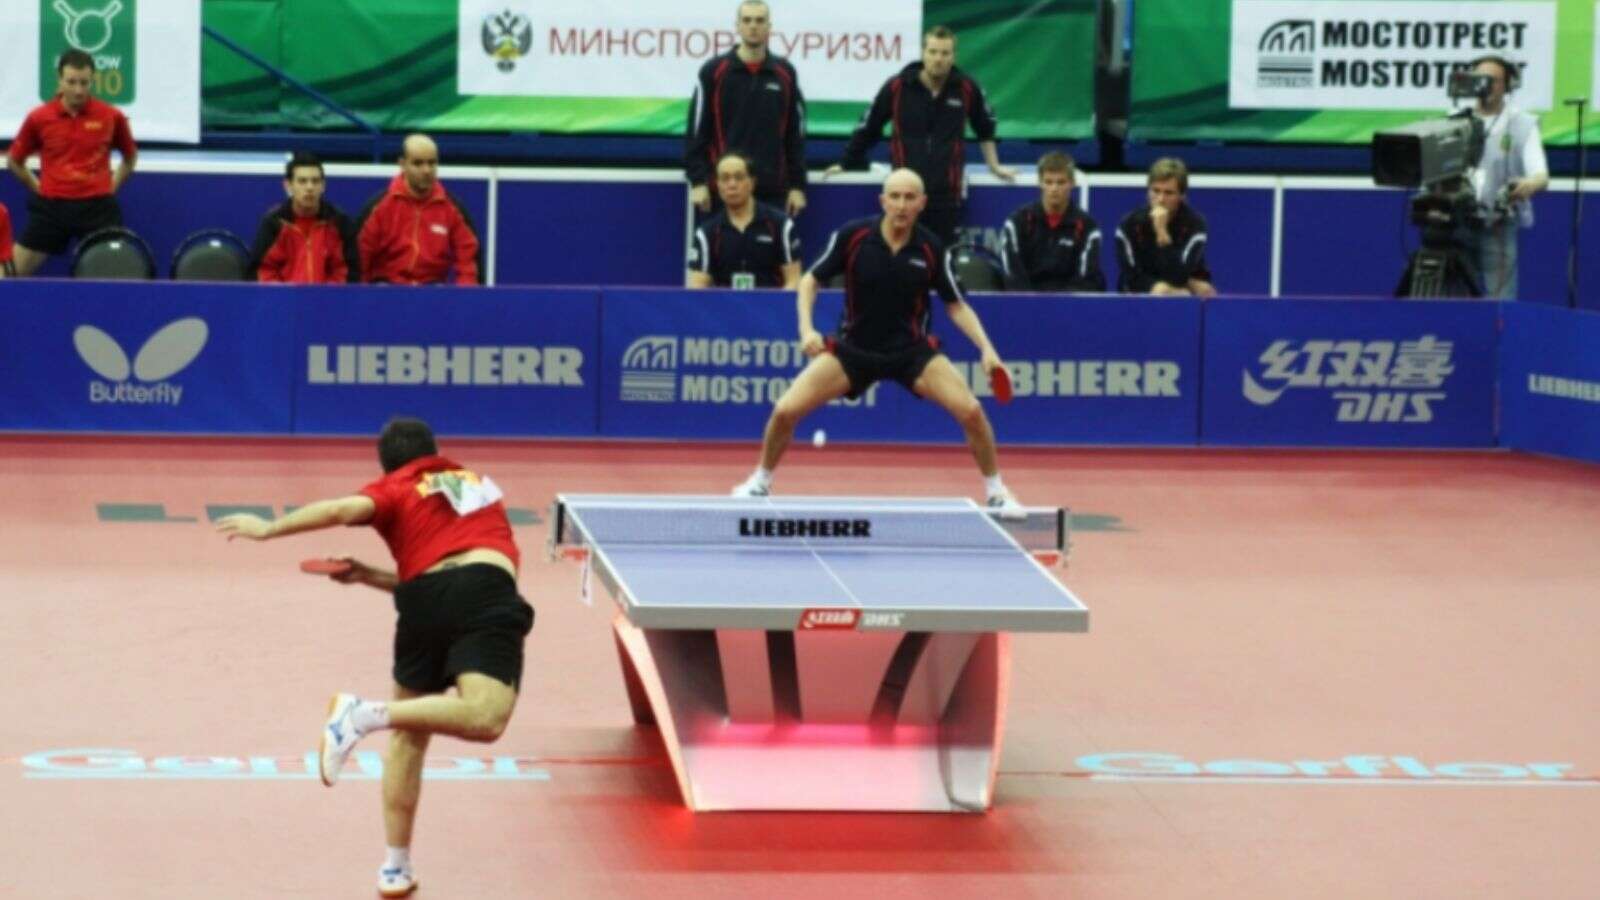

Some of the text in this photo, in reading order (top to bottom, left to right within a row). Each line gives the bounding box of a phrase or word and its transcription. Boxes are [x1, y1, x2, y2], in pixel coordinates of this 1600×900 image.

[549, 28, 902, 60] МИНСПОРУРИЗМ
[1321, 21, 1527, 49] МОСТОТРЕСТ
[307, 345, 584, 385] LIEBHERR
[1242, 335, 1455, 405] 红双喜
[90, 381, 183, 406] Butterfly
[1332, 391, 1446, 422] DHS
[738, 517, 872, 538] LIEBHERR
[1075, 752, 1574, 778] Gerflor
